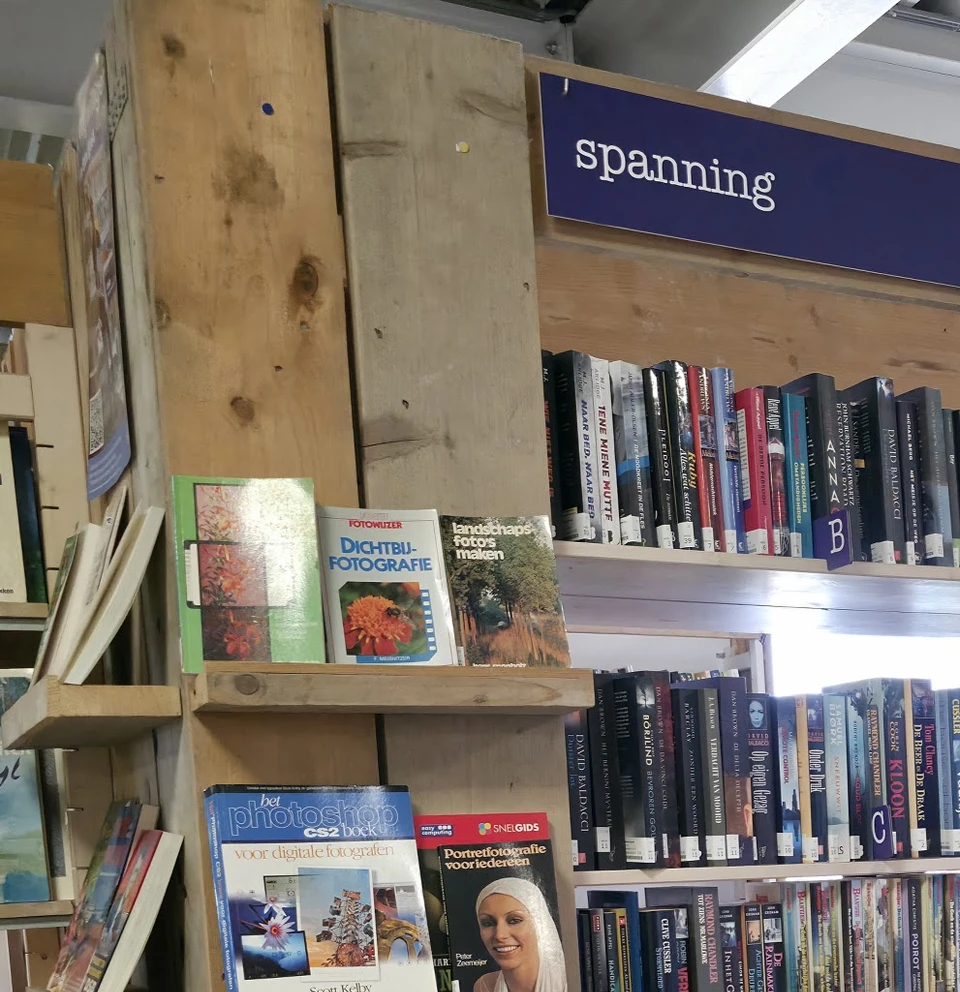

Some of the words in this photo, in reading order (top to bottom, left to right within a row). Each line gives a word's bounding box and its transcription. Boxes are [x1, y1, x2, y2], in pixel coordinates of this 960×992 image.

[576, 138, 776, 211] spanning
[888, 429, 897, 463] DAVID
[826, 440, 840, 504] ANNA
[891, 467, 902, 520] BALDACCI
[349, 519, 403, 530] FOTOWIJZER
[340, 536, 418, 556] DICHTBIJ-
[453, 535, 497, 548] foto's
[829, 518, 845, 554] B
[328, 556, 433, 572] FOTOGRAFIE
[456, 548, 505, 561] maken
[924, 724, 935, 743] Tom
[576, 735, 585, 771] DAVID
[751, 751, 768, 762] Op
[809, 749, 825, 772] Onder
[924, 745, 937, 776] Clancy
[751, 765, 767, 787] eigen
[810, 774, 827, 793] Druk
[260, 793, 281, 807] het
[889, 759, 906, 820] KLOON
[578, 775, 590, 833] BALDACCI
[752, 790, 772, 815] Gezag
[229, 799, 399, 837] photoshop
[493, 823, 540, 834] SNELGIDS
[871, 810, 886, 844] C
[303, 826, 340, 838] CS2
[341, 822, 378, 837] boek
[235, 848, 270, 860] voor
[273, 844, 324, 863] digitale
[326, 842, 395, 861] fotografen
[443, 843, 547, 860] Portretfotografie
[444, 860, 475, 871] voor
[474, 857, 531, 870] iedereen
[704, 894, 715, 937] RAYMOND
[660, 919, 670, 941] CLIVE
[662, 942, 672, 975] CUSSLER
[707, 937, 719, 984] CHANDLER
[773, 953, 784, 968] DE
[911, 933, 920, 971] POIROT
